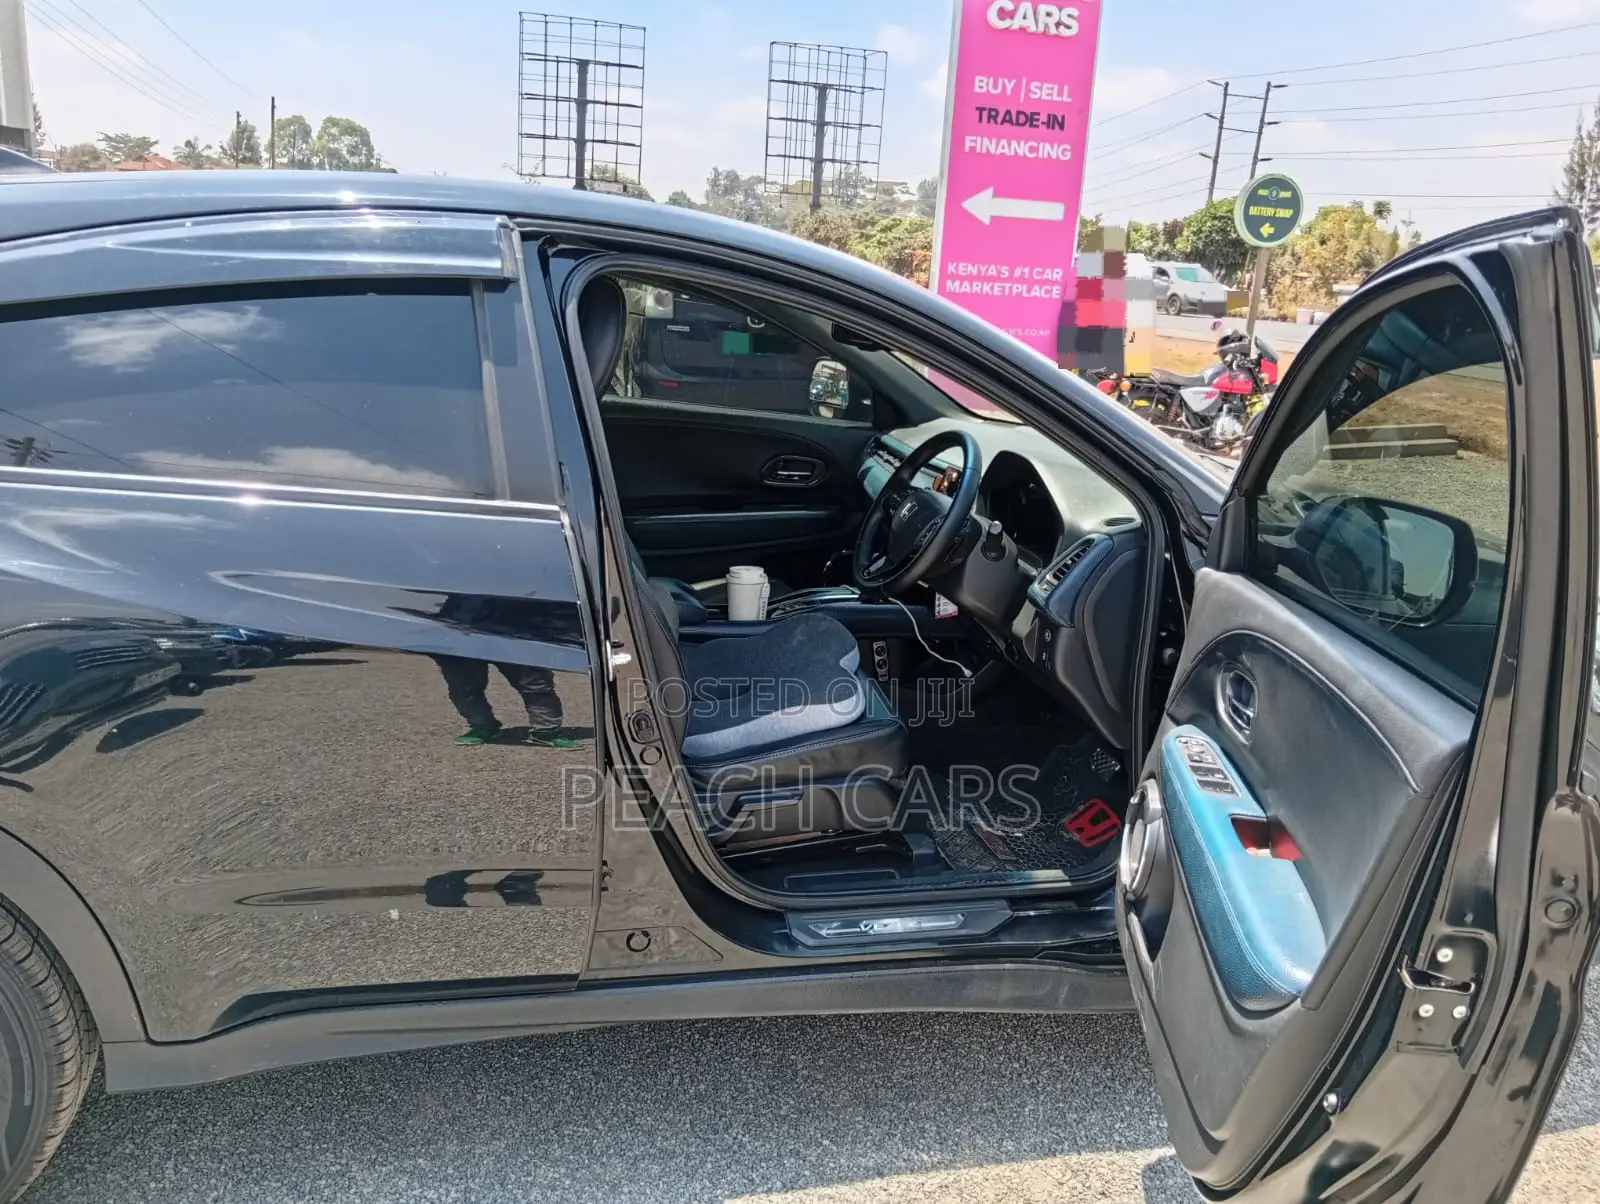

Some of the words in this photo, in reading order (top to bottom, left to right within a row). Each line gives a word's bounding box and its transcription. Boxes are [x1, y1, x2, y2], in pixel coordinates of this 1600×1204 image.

[986, 0, 1080, 37] CARS
[973, 75, 1016, 96] BUY
[1028, 81, 1073, 103] SELL
[975, 106, 1066, 131] TRADE-IN
[964, 135, 1072, 161] FINANCING
[947, 261, 1009, 279] KENYA'S
[1013, 266, 1029, 279] #1
[1032, 267, 1063, 282] CAR
[945, 279, 1062, 299] MARKETPLACE
